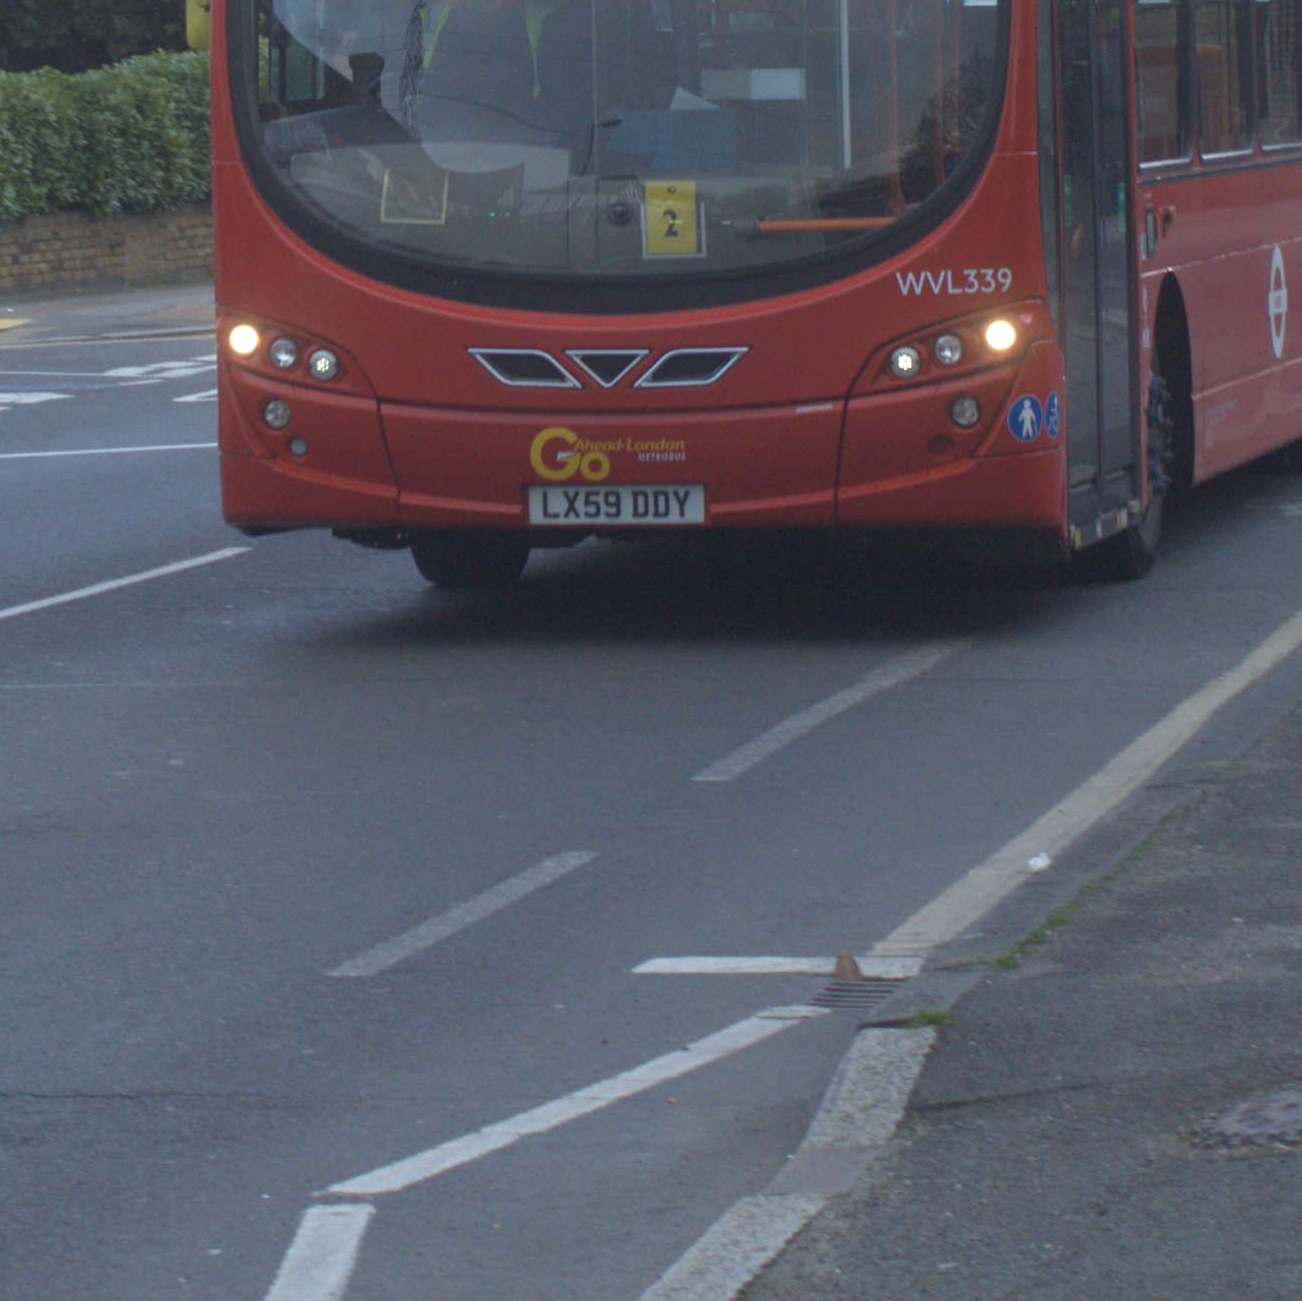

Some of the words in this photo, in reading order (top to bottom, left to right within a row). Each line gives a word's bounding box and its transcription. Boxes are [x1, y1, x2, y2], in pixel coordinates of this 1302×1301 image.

[662, 208, 679, 238] 2
[895, 267, 1013, 296] WVL339
[529, 426, 611, 481] Go
[574, 436, 686, 452] Ahead-London
[637, 451, 686, 462] METROBUS
[541, 489, 622, 520] LX59
[631, 489, 691, 519] DDY
